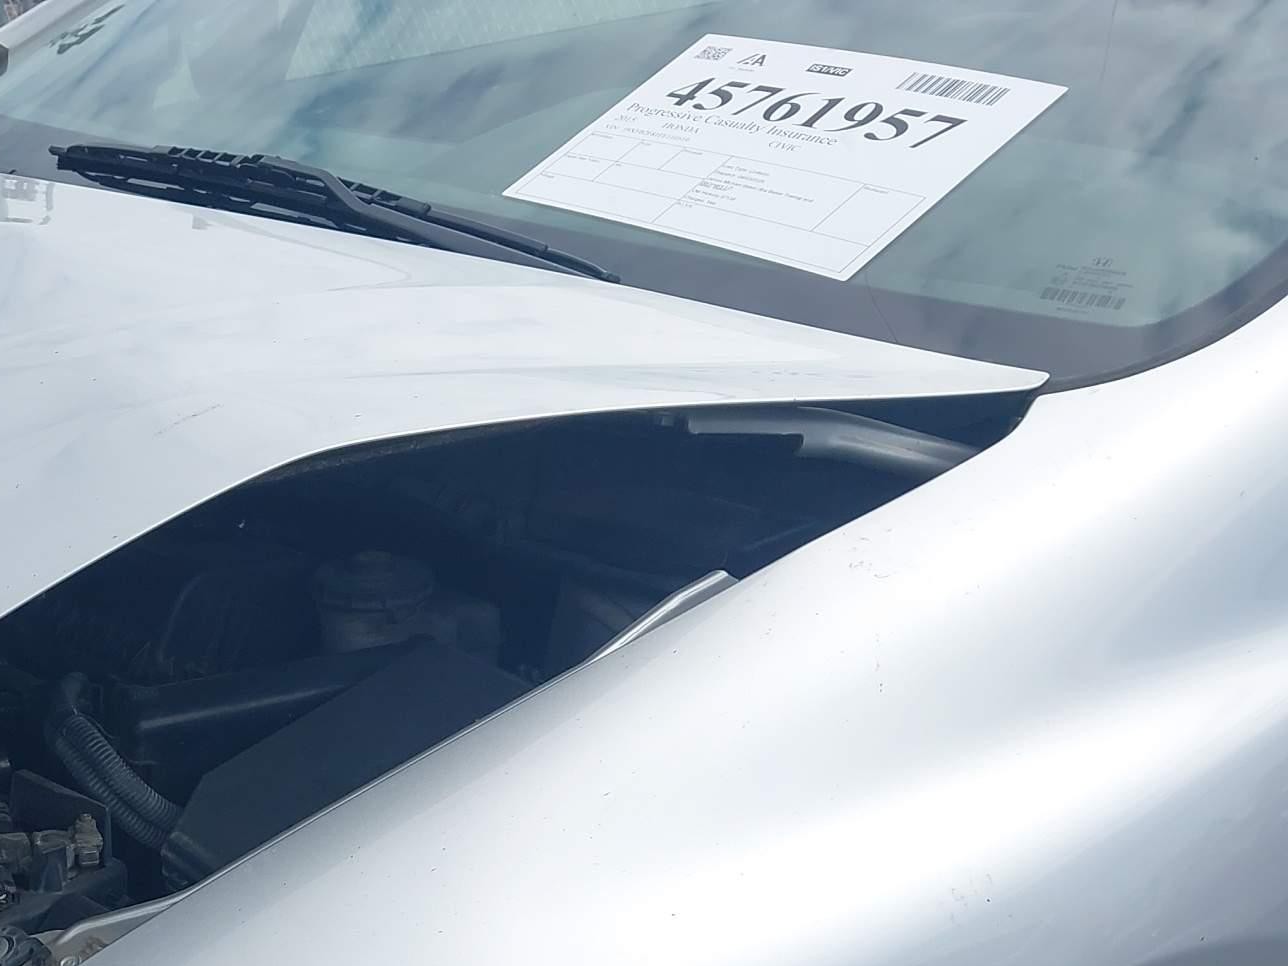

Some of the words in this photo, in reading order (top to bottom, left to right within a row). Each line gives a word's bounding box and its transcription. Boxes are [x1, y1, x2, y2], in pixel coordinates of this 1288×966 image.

[626, 102, 703, 124] Progressive
[704, 113, 763, 134] Casualty
[765, 125, 839, 147] Insurance
[665, 77, 969, 148] 45761957
